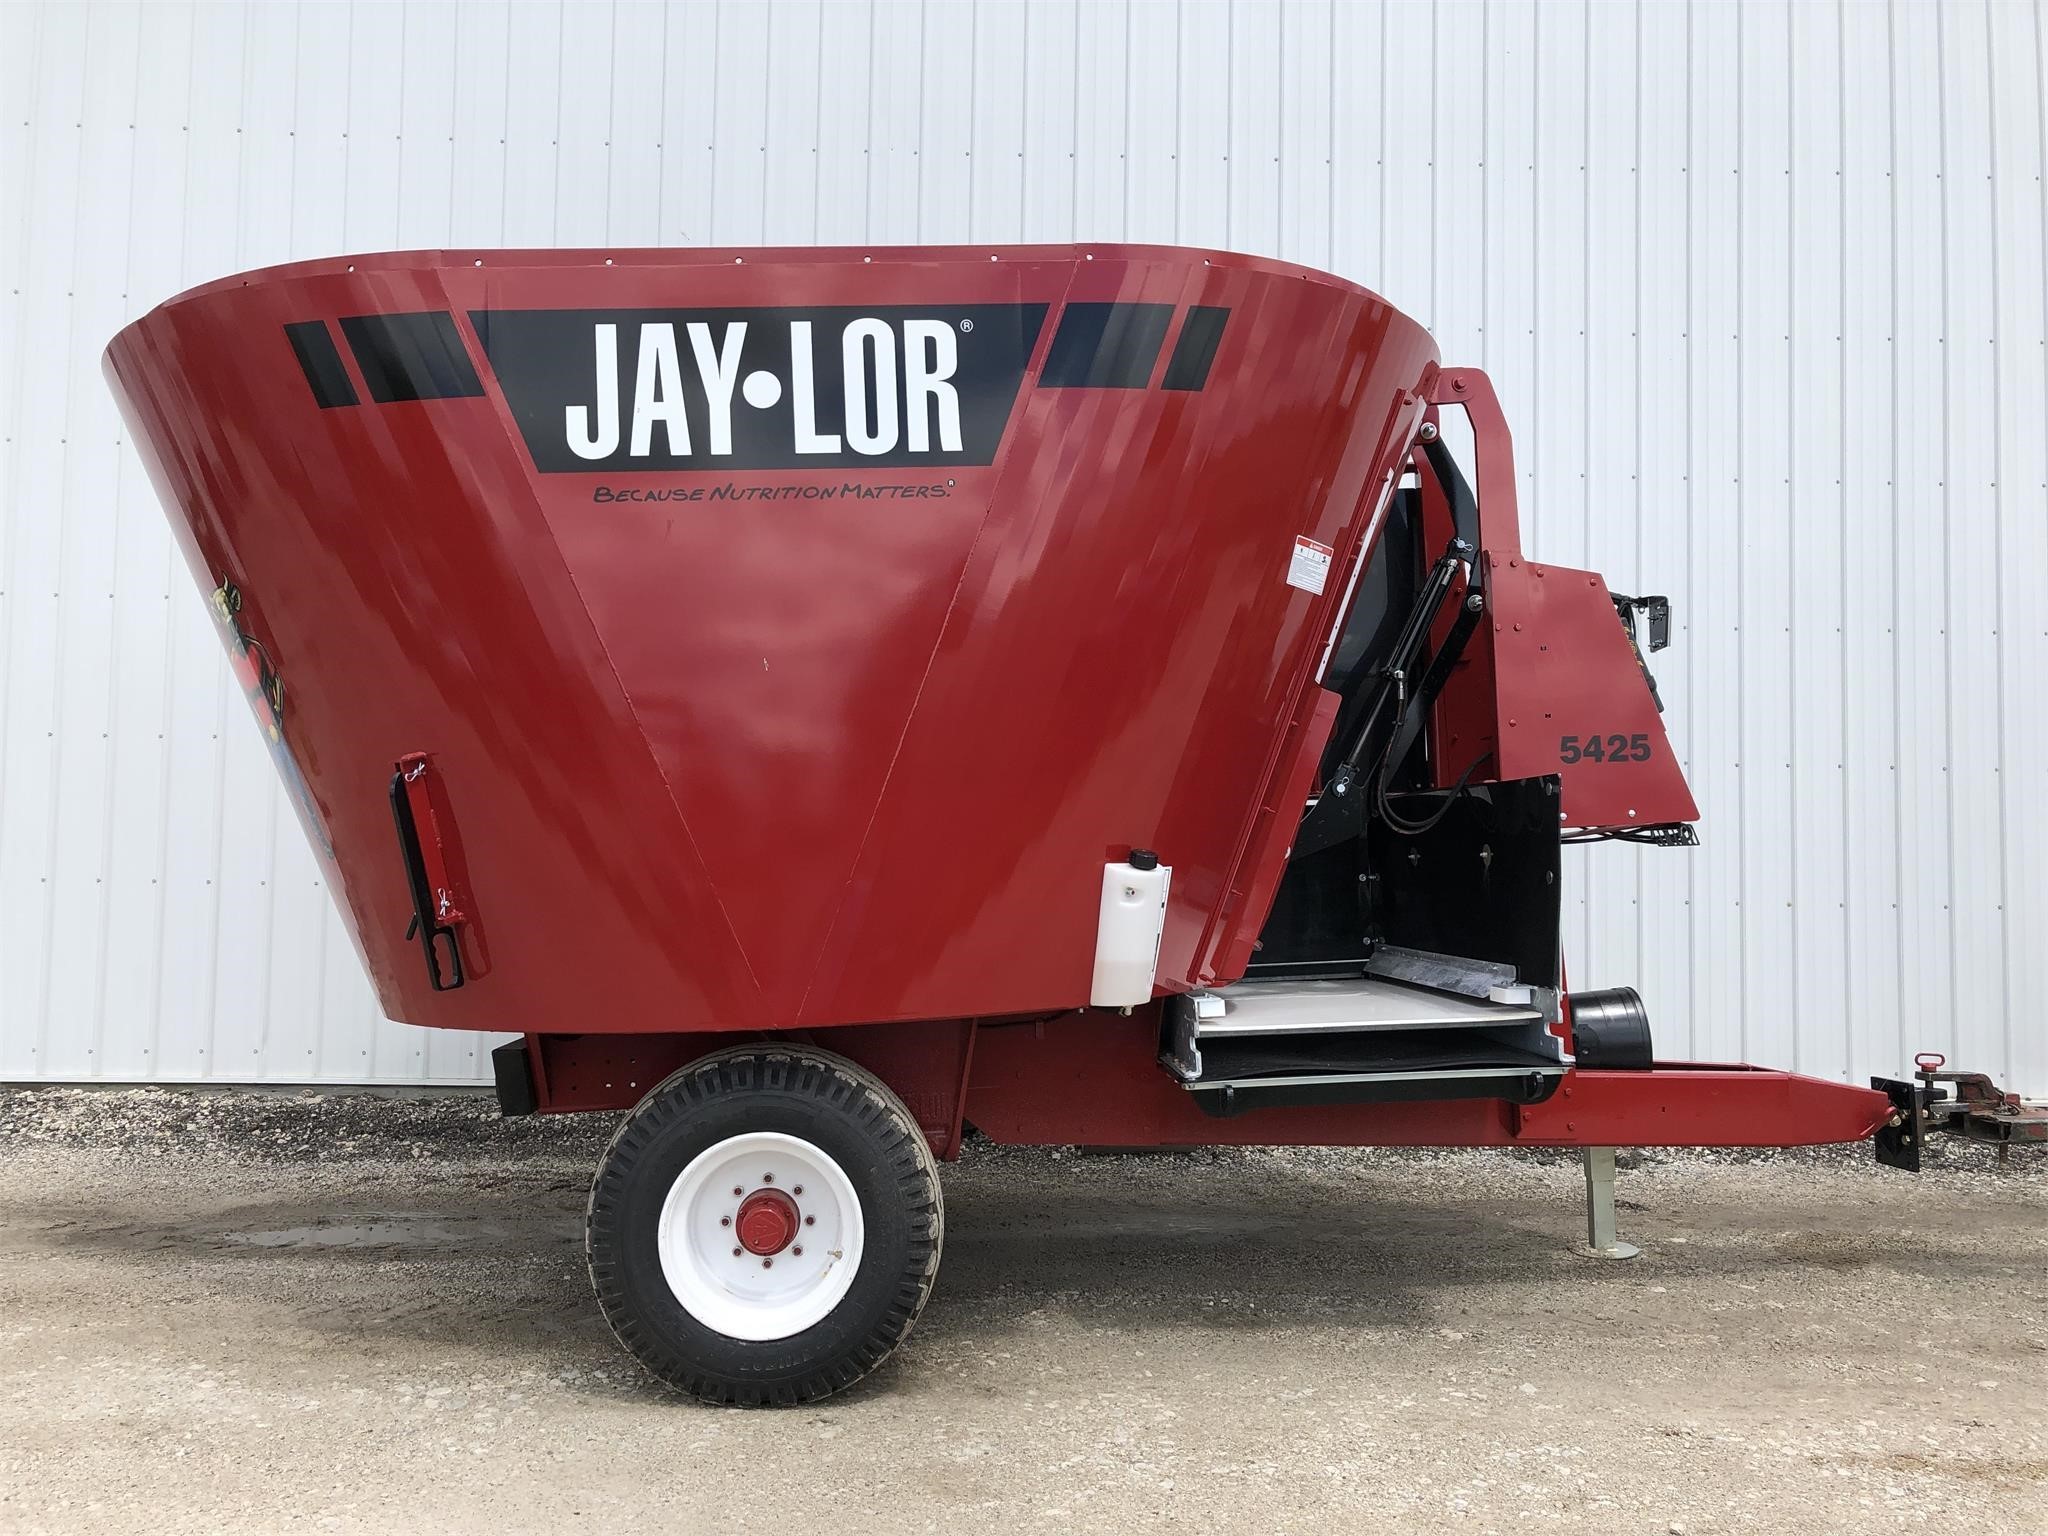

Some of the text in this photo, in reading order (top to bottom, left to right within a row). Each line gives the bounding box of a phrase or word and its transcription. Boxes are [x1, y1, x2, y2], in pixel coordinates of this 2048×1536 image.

[593, 486, 705, 503] BECAUSE
[710, 483, 837, 501] NUTRITION
[1560, 733, 1651, 764] 5425
